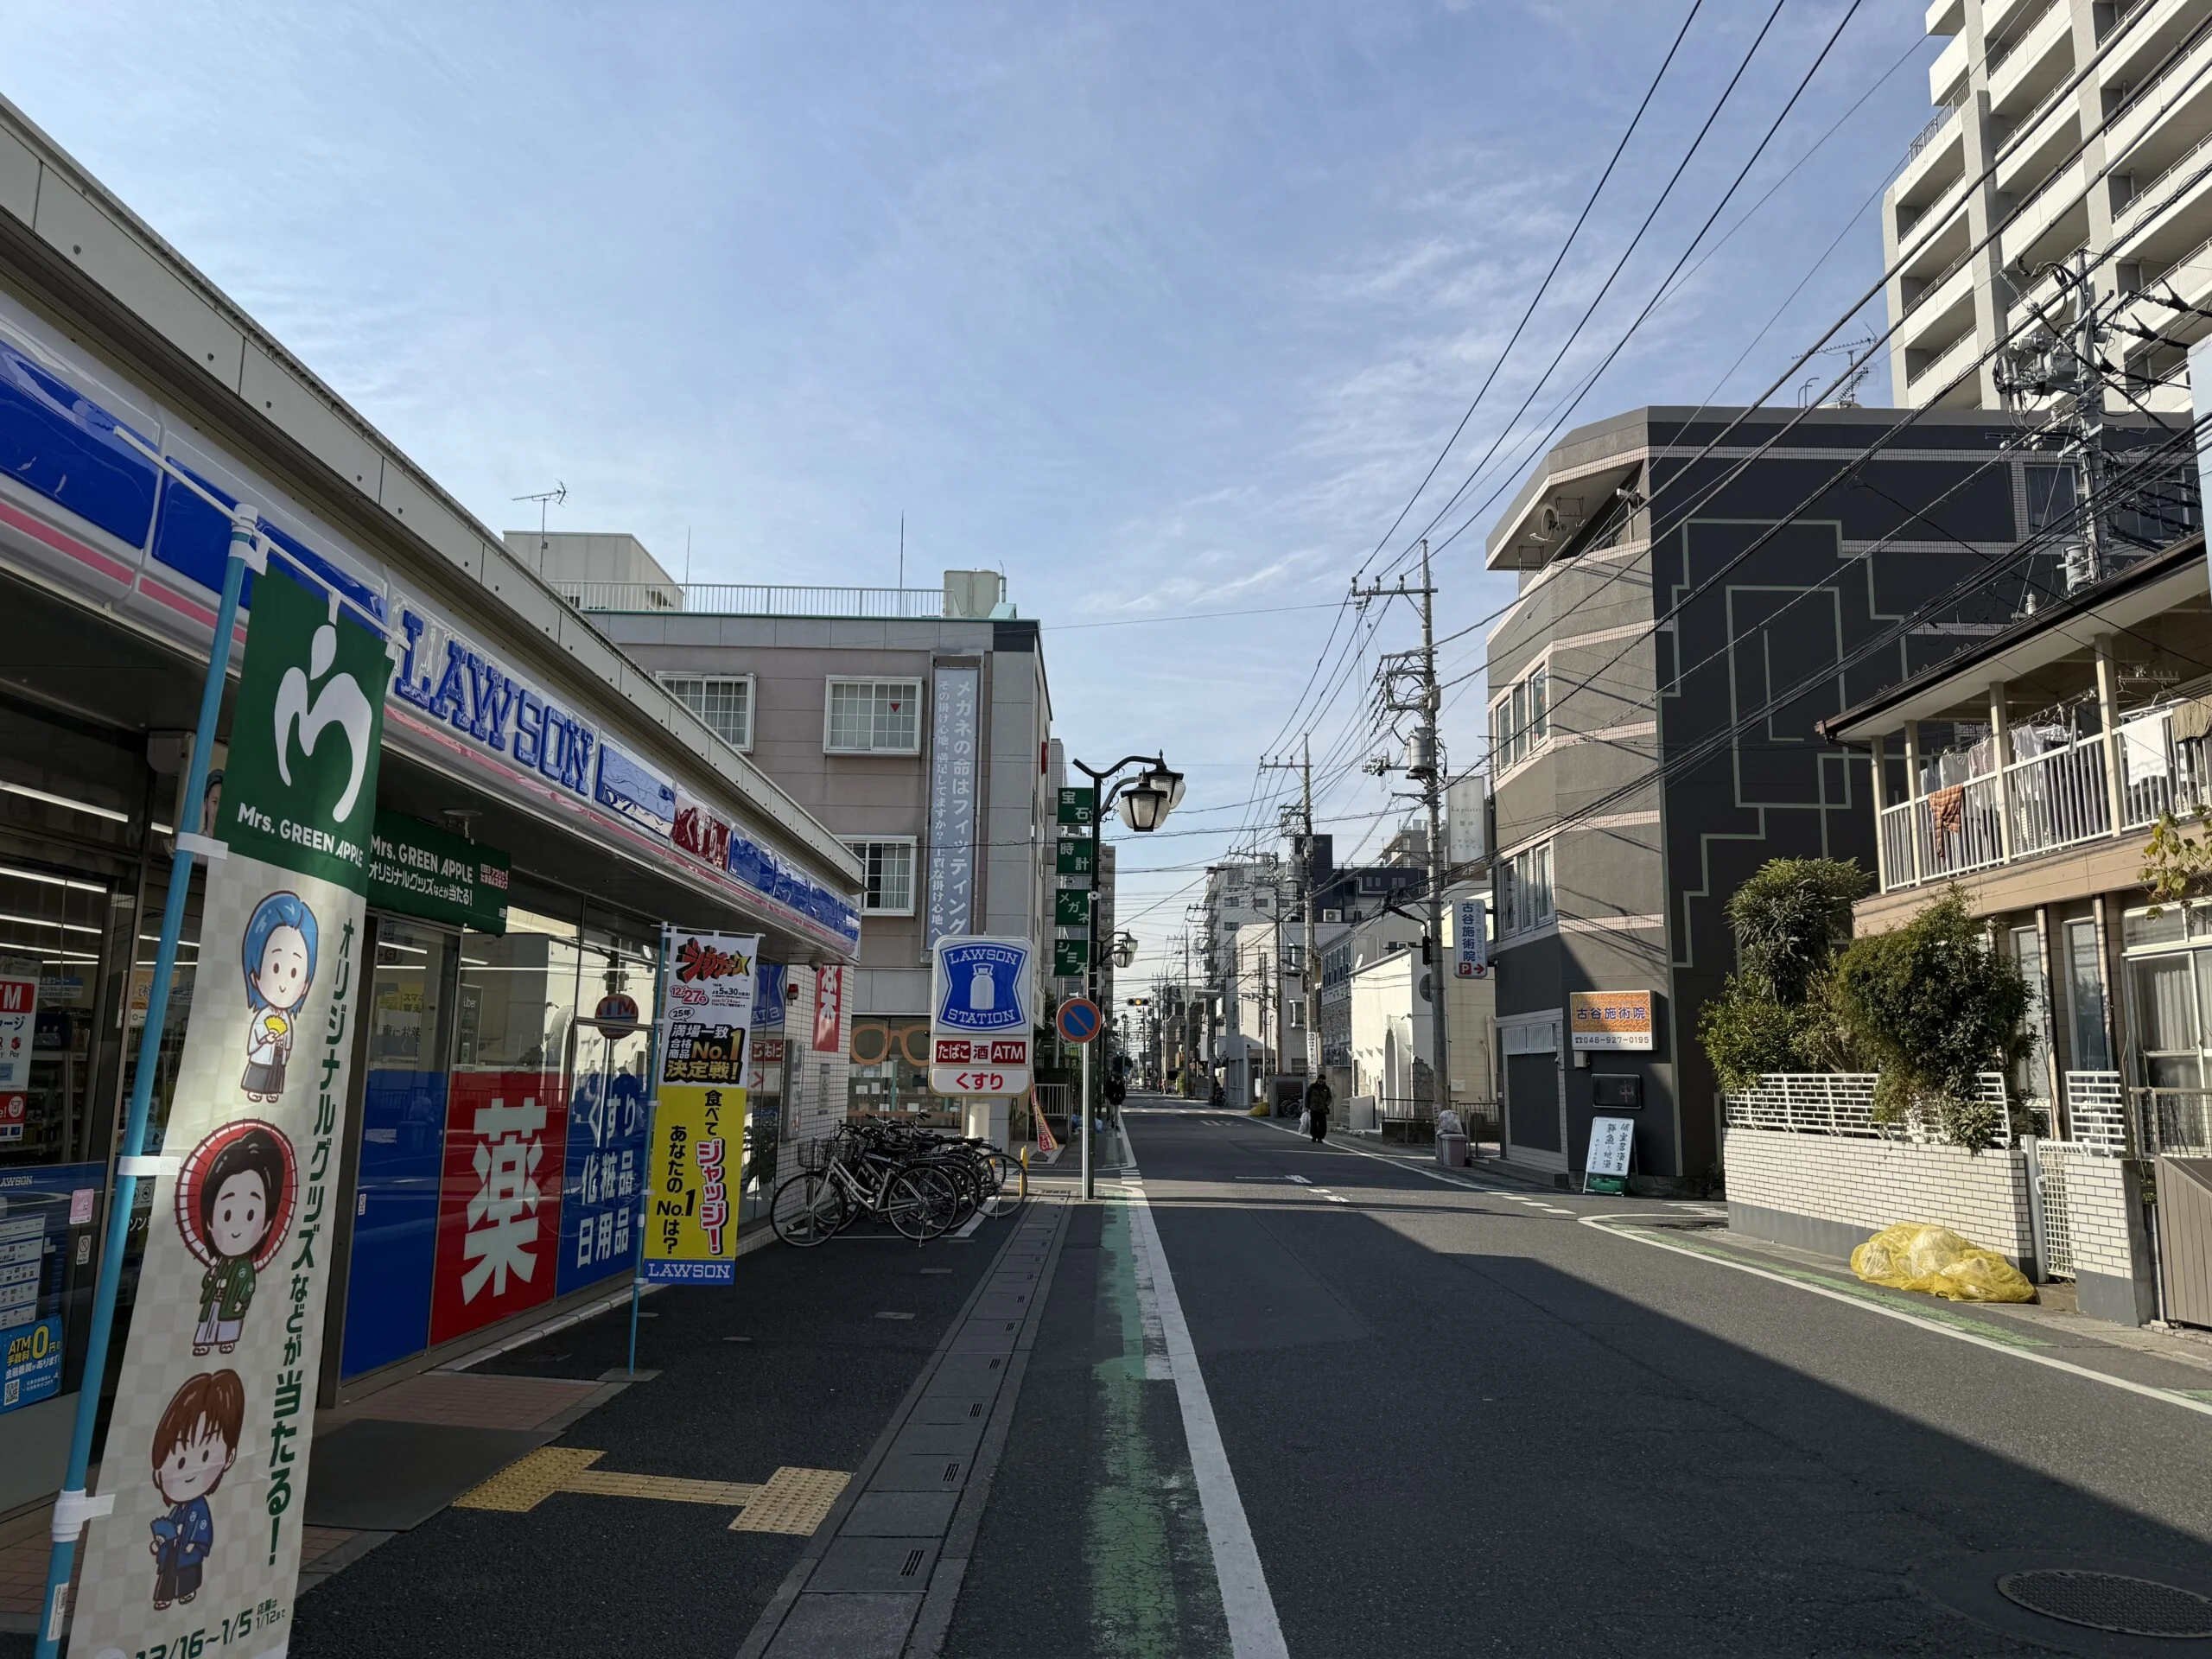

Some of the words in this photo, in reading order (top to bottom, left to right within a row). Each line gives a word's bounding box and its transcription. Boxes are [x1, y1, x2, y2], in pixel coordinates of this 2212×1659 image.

[395, 609, 594, 796] LAWSON
[949, 681, 972, 935] メガネの命はフィッティング
[1062, 791, 1089, 820] 宝石
[238, 803, 275, 834] Mrs.
[280, 819, 334, 854] GREEN
[335, 840, 364, 868] APPLE
[370, 834, 396, 861] Mrs.
[398, 843, 438, 874] GREEN
[441, 858, 474, 884] APPLE
[1060, 842, 1090, 871] 時計
[1059, 893, 1089, 923] メガネ
[1461, 902, 1475, 962] 古谷施術院
[949, 949, 1018, 965] LAWSON
[673, 1010, 691, 1019] 25年
[948, 1008, 1015, 1025] STATION
[1576, 1007, 1645, 1020] 古谷施術院
[671, 1023, 728, 1039] 満場一致
[668, 1048, 690, 1059] 商品
[670, 1039, 691, 1050] 合格
[691, 1028, 741, 1061] No.1
[938, 1044, 969, 1059] たばこ
[974, 1045, 988, 1059] 酒
[993, 1046, 1024, 1060] ATM
[666, 1059, 739, 1080] 決定戦!
[956, 1072, 1004, 1090] くすり
[588, 1093, 636, 1141] くすり
[0, 1175, 33, 1187] AWSON
[582, 1150, 633, 1205] 化粧品
[461, 1097, 548, 1306] 薬
[577, 1206, 629, 1268] 日用品
[648, 1263, 731, 1279] LAWSON
[9, 1335, 31, 1356] ATM
